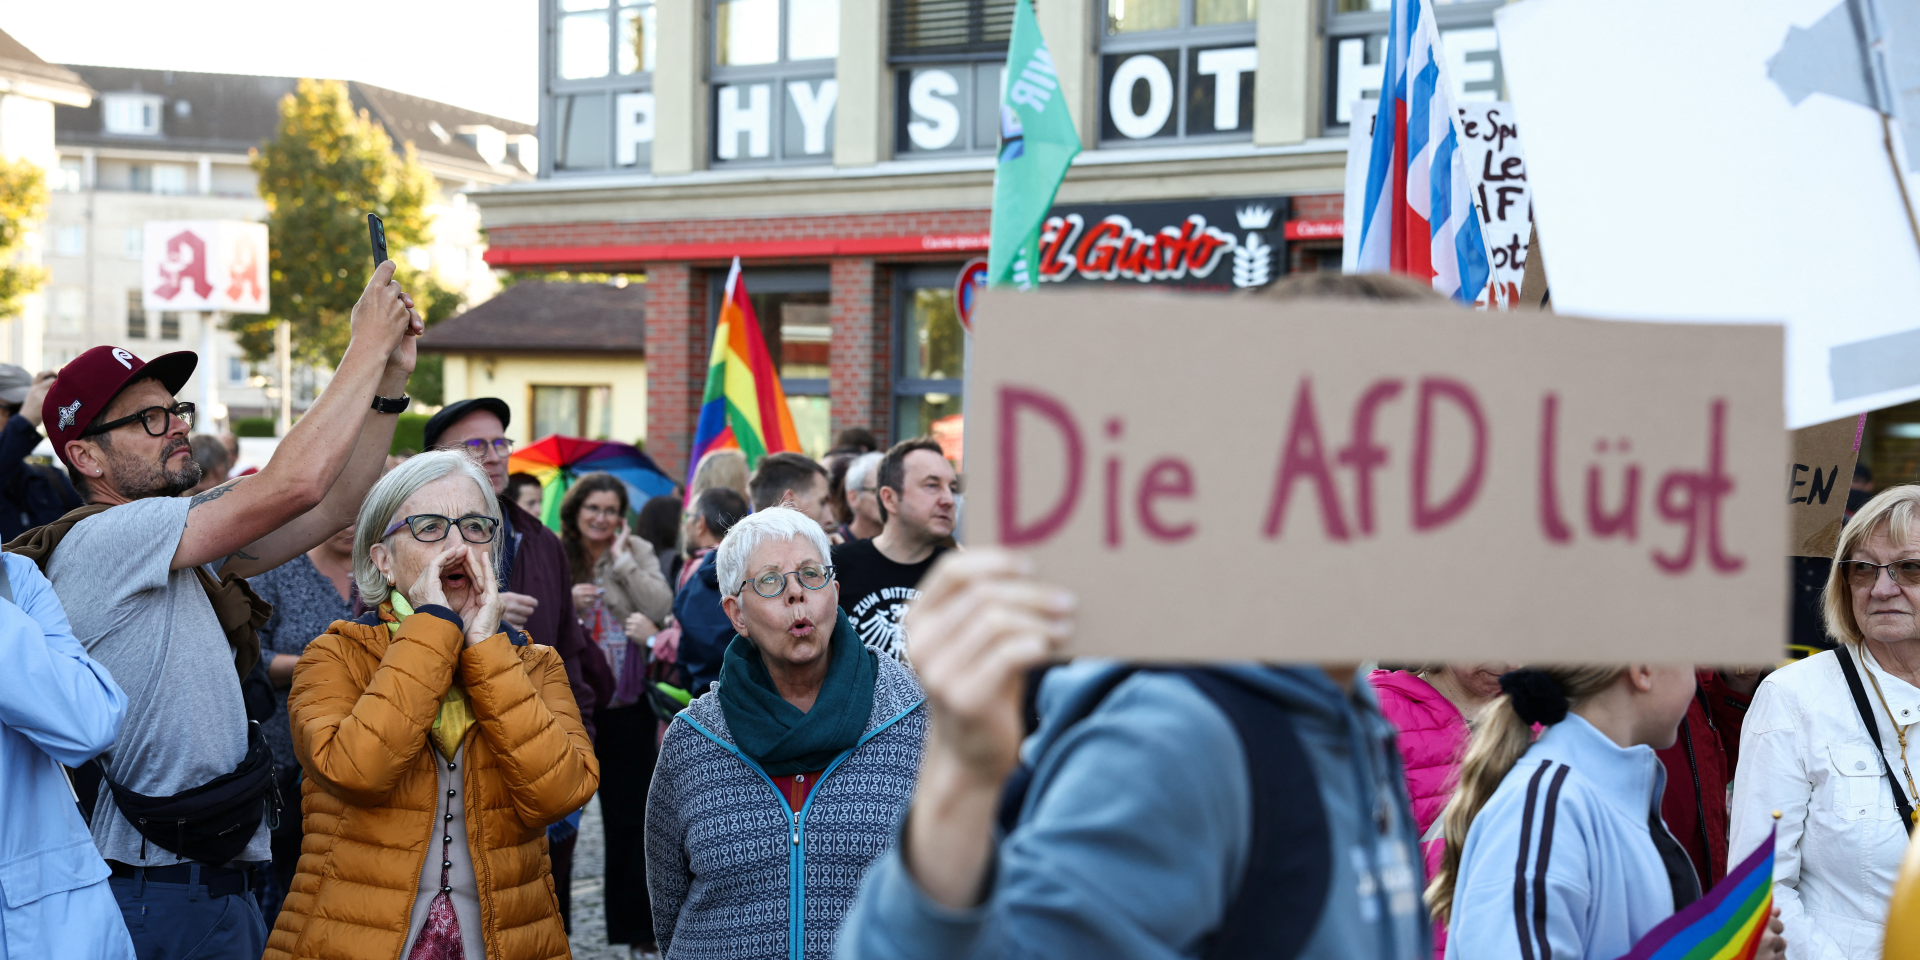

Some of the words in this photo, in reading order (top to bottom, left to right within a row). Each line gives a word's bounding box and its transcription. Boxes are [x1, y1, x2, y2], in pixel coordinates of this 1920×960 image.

[1075, 213, 1237, 283] Gusto
[996, 384, 1196, 550] Die
[1262, 371, 1489, 543] AfD
[1537, 390, 1747, 576] lügt
[853, 592, 880, 617] ZUM
